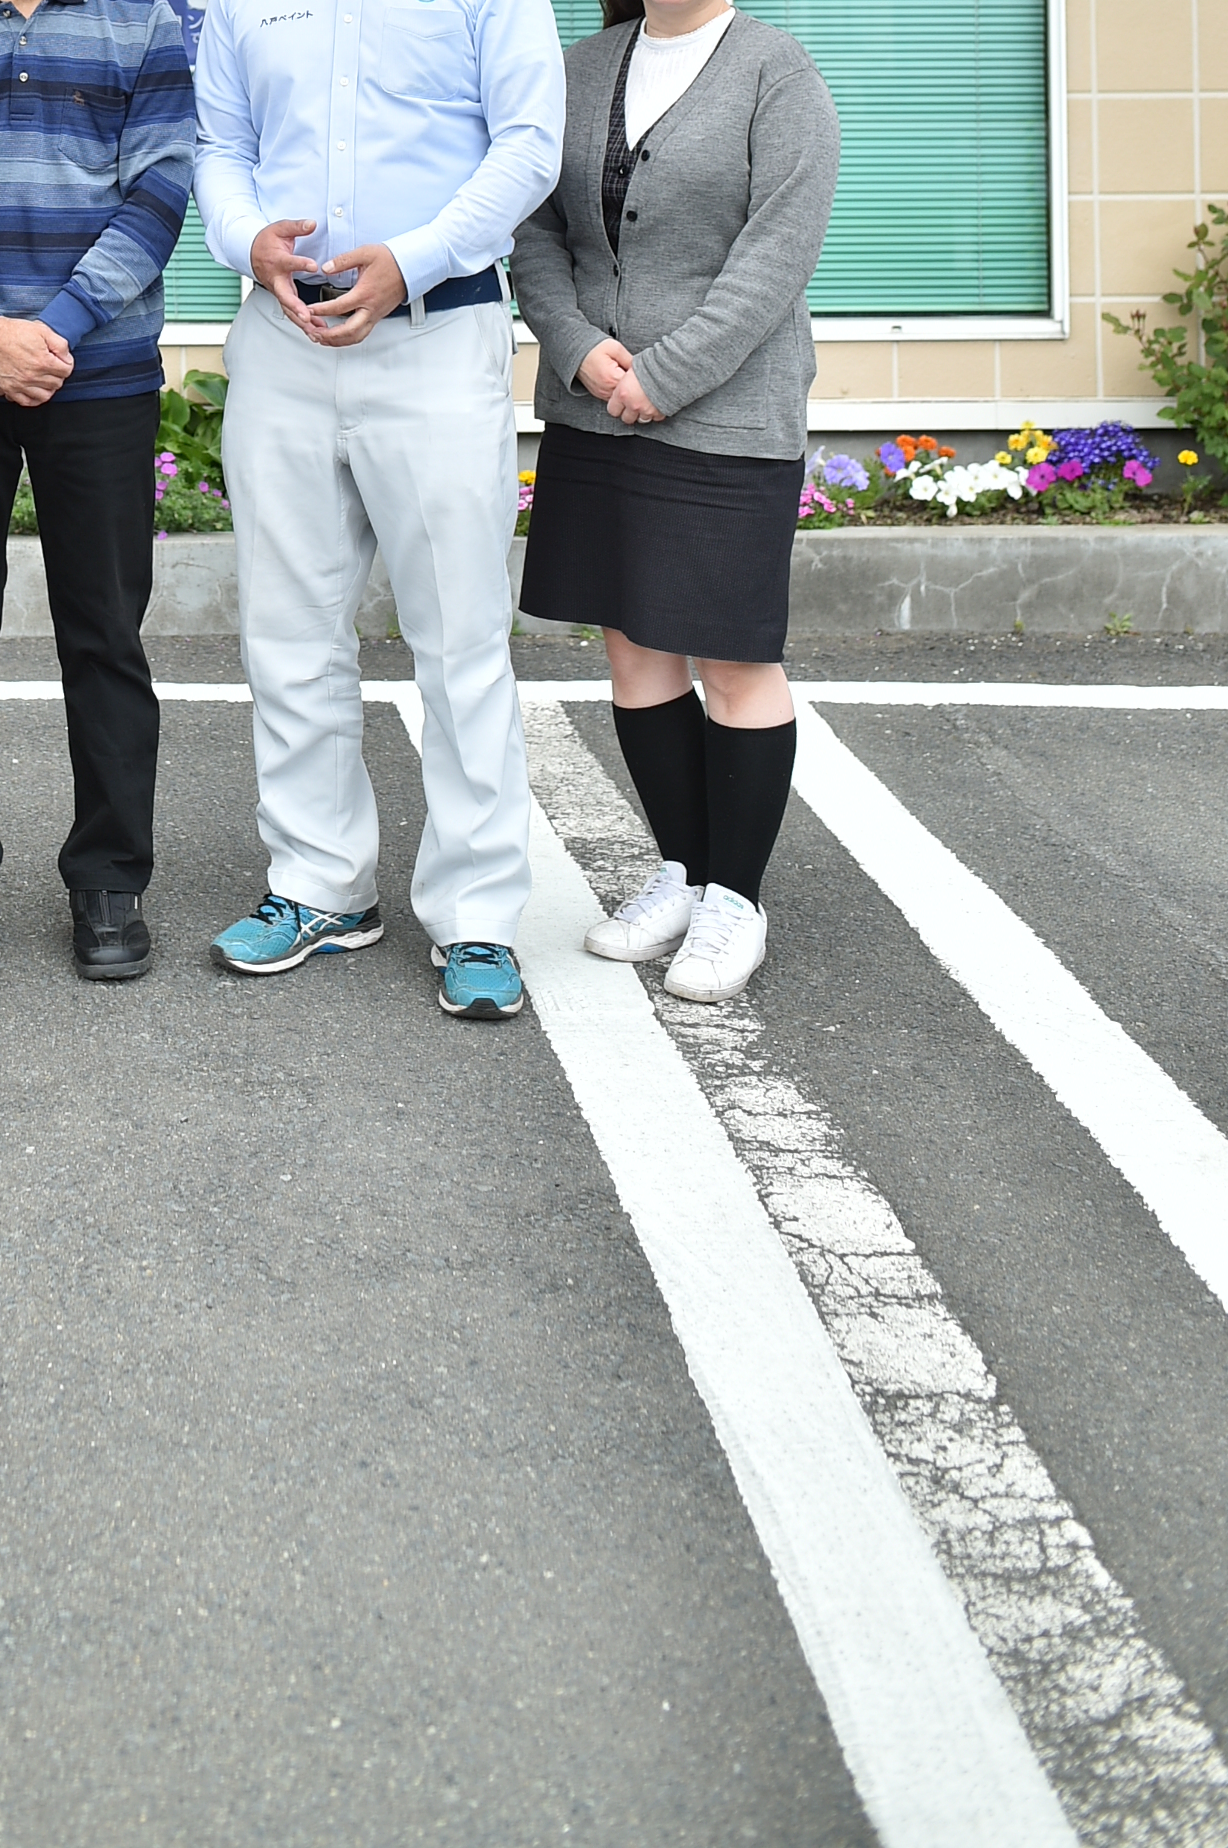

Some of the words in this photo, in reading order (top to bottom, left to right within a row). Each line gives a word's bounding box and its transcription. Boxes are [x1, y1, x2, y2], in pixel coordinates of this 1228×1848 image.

[259, 9, 314, 28] 八戸ペイント
